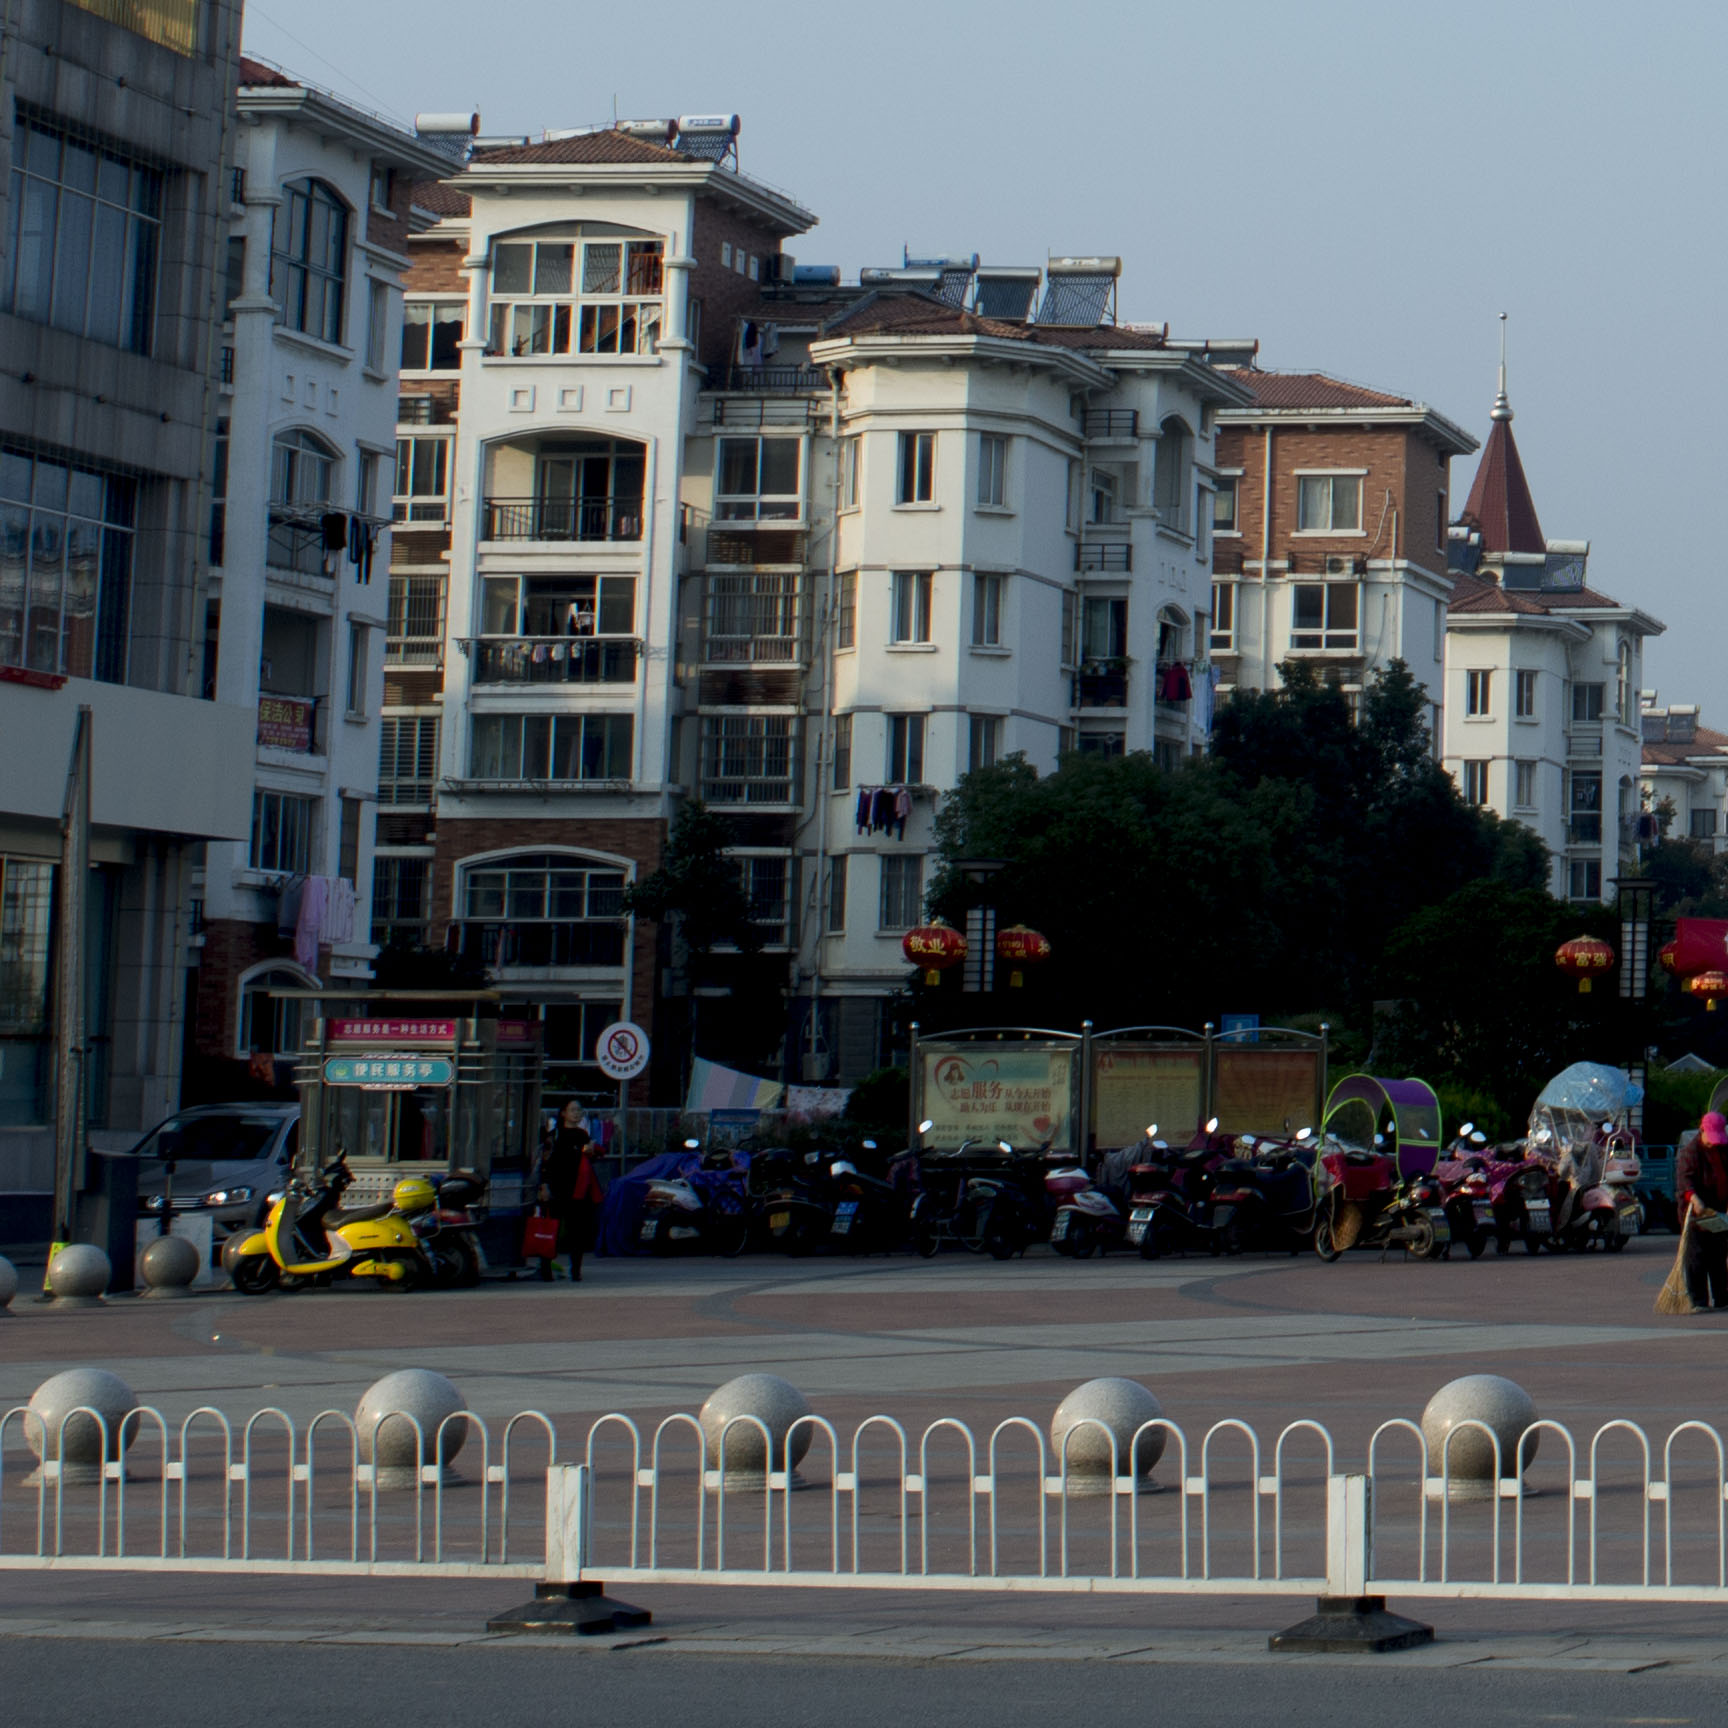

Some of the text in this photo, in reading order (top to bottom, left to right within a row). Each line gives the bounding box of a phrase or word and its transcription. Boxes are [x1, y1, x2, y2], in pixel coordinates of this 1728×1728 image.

[260, 700, 305, 726] 保洁公司
[910, 936, 947, 956] 敬业
[1574, 952, 1607, 968] 富强
[354, 1062, 433, 1077] 便民服务亭
